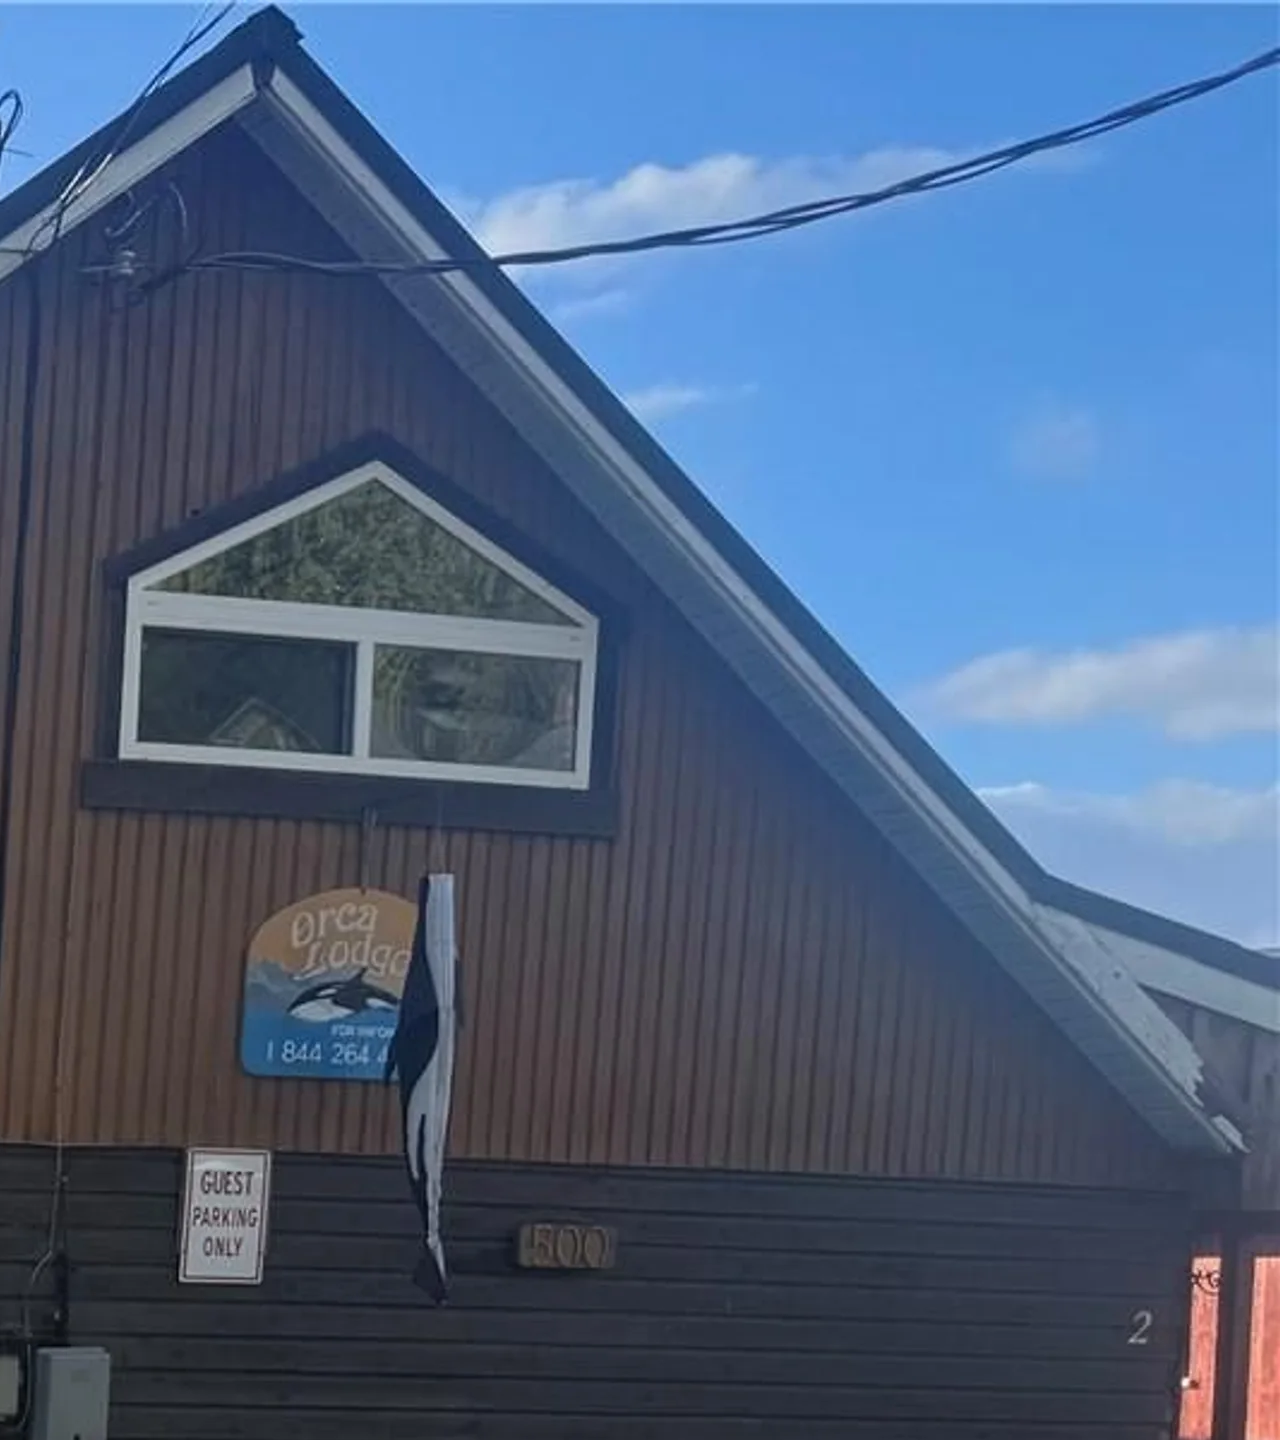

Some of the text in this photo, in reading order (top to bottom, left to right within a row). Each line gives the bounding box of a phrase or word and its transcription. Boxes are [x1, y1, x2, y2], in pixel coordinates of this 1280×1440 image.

[291, 902, 379, 949] Orca
[266, 1040, 274, 1062] 1
[281, 1040, 321, 1063] 844
[330, 1042, 369, 1065] 264
[200, 1170, 255, 1195] GUEST
[192, 1206, 258, 1227] PARKING
[203, 1236, 244, 1257] ONLY
[1127, 1310, 1152, 1345] 2
